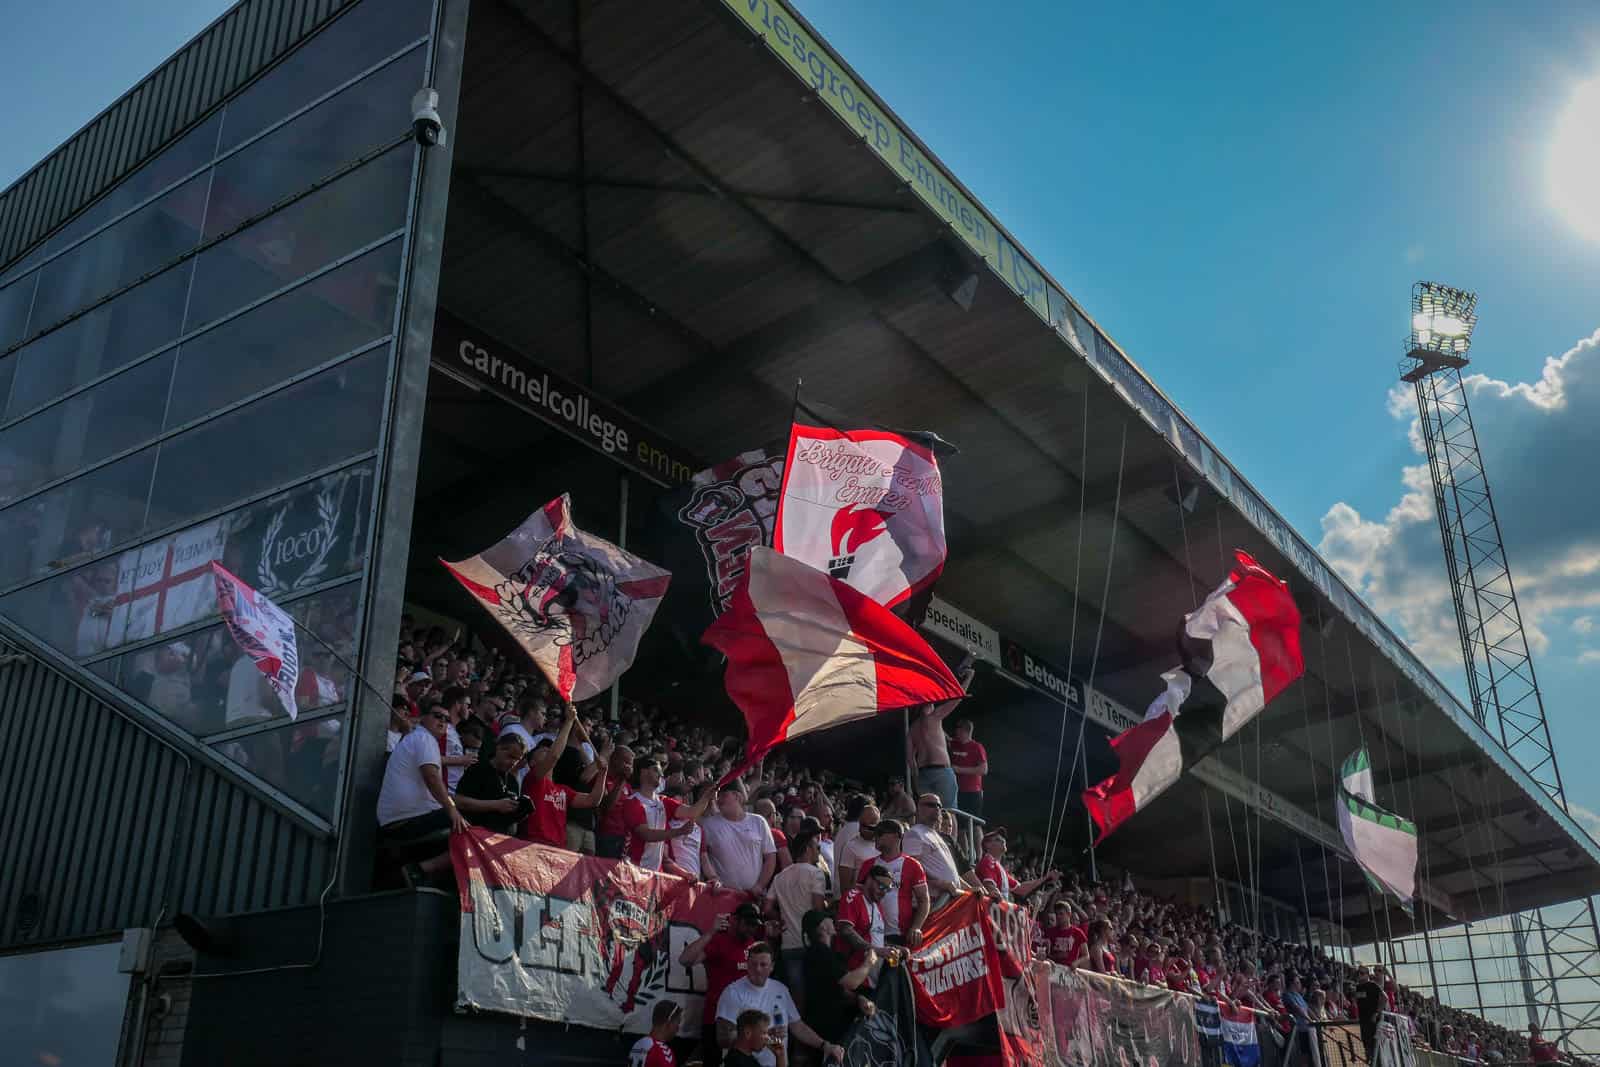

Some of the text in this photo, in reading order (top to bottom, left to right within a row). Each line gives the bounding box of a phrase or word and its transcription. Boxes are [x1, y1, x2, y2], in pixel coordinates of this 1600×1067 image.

[896, 130, 987, 245] Emmen
[459, 340, 698, 484] carmelcollege emm
[1024, 655, 1079, 703] Betonza
